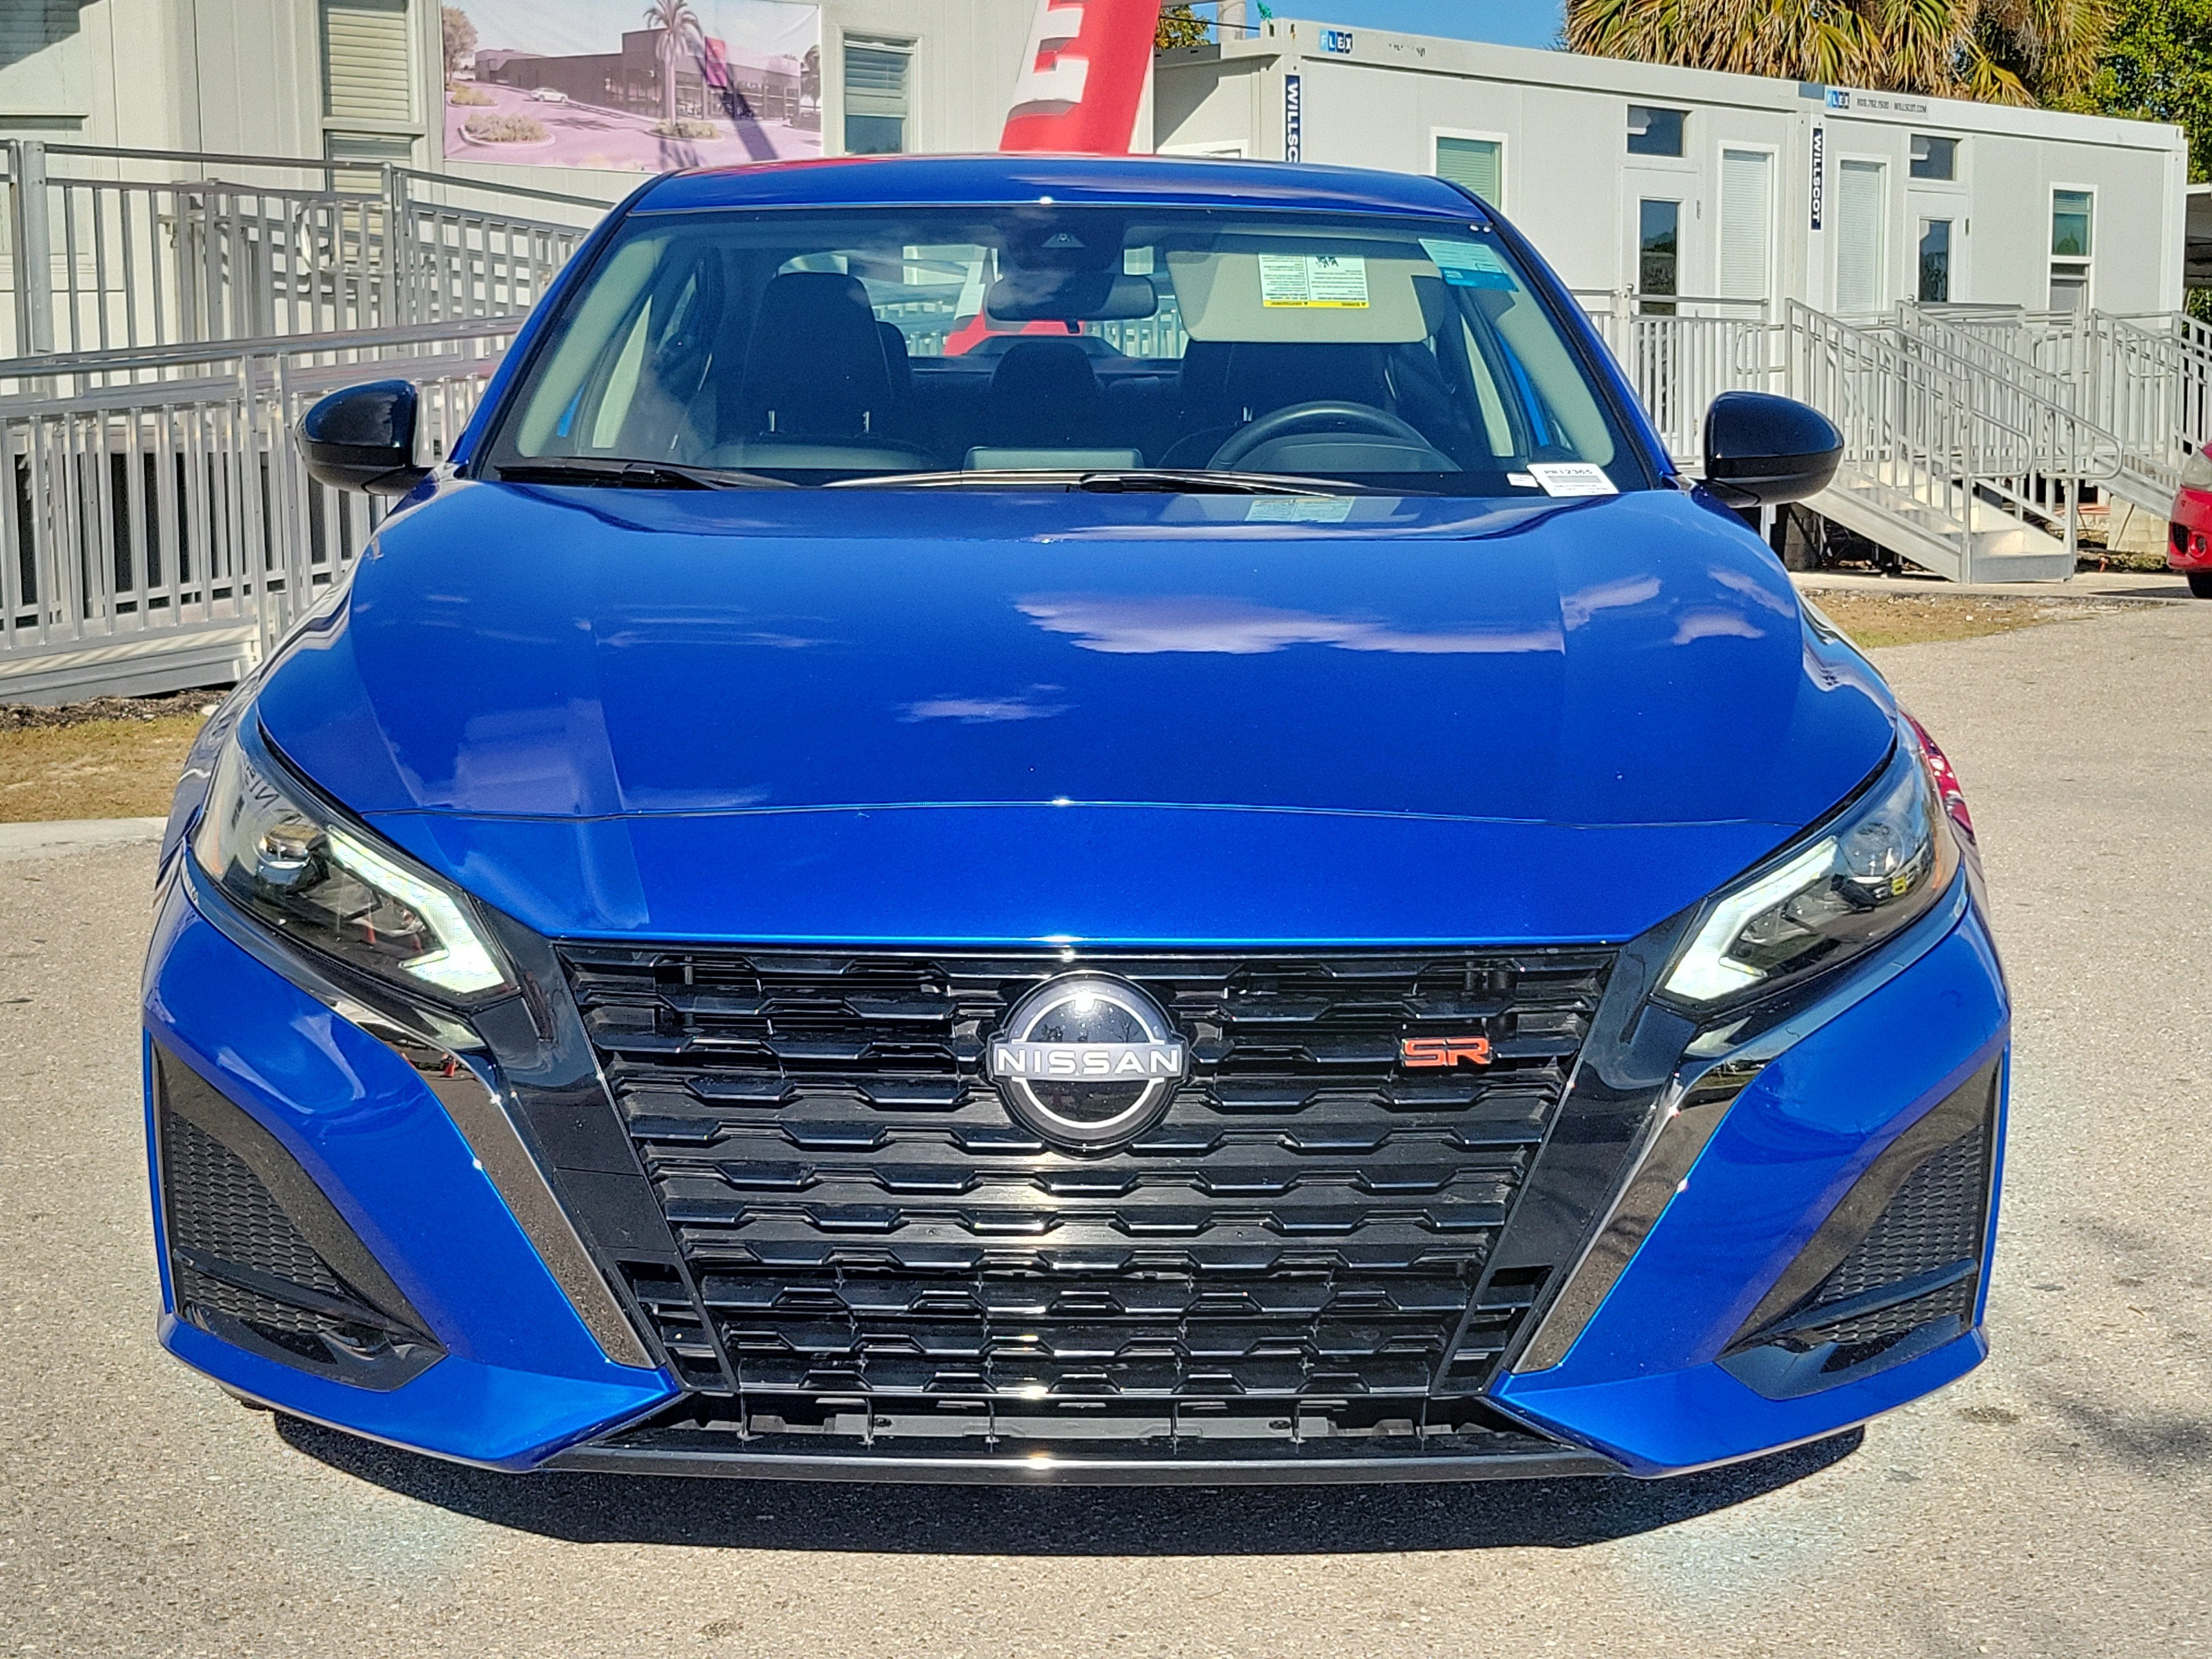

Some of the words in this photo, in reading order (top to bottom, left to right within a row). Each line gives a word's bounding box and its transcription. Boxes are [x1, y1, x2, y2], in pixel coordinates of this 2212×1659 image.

[1320, 33, 1353, 53] FLEX
[1812, 133, 1822, 222] WILLSCOT
[997, 1049, 1178, 1075] NISSAN
[1403, 1036, 1491, 1066] SR
